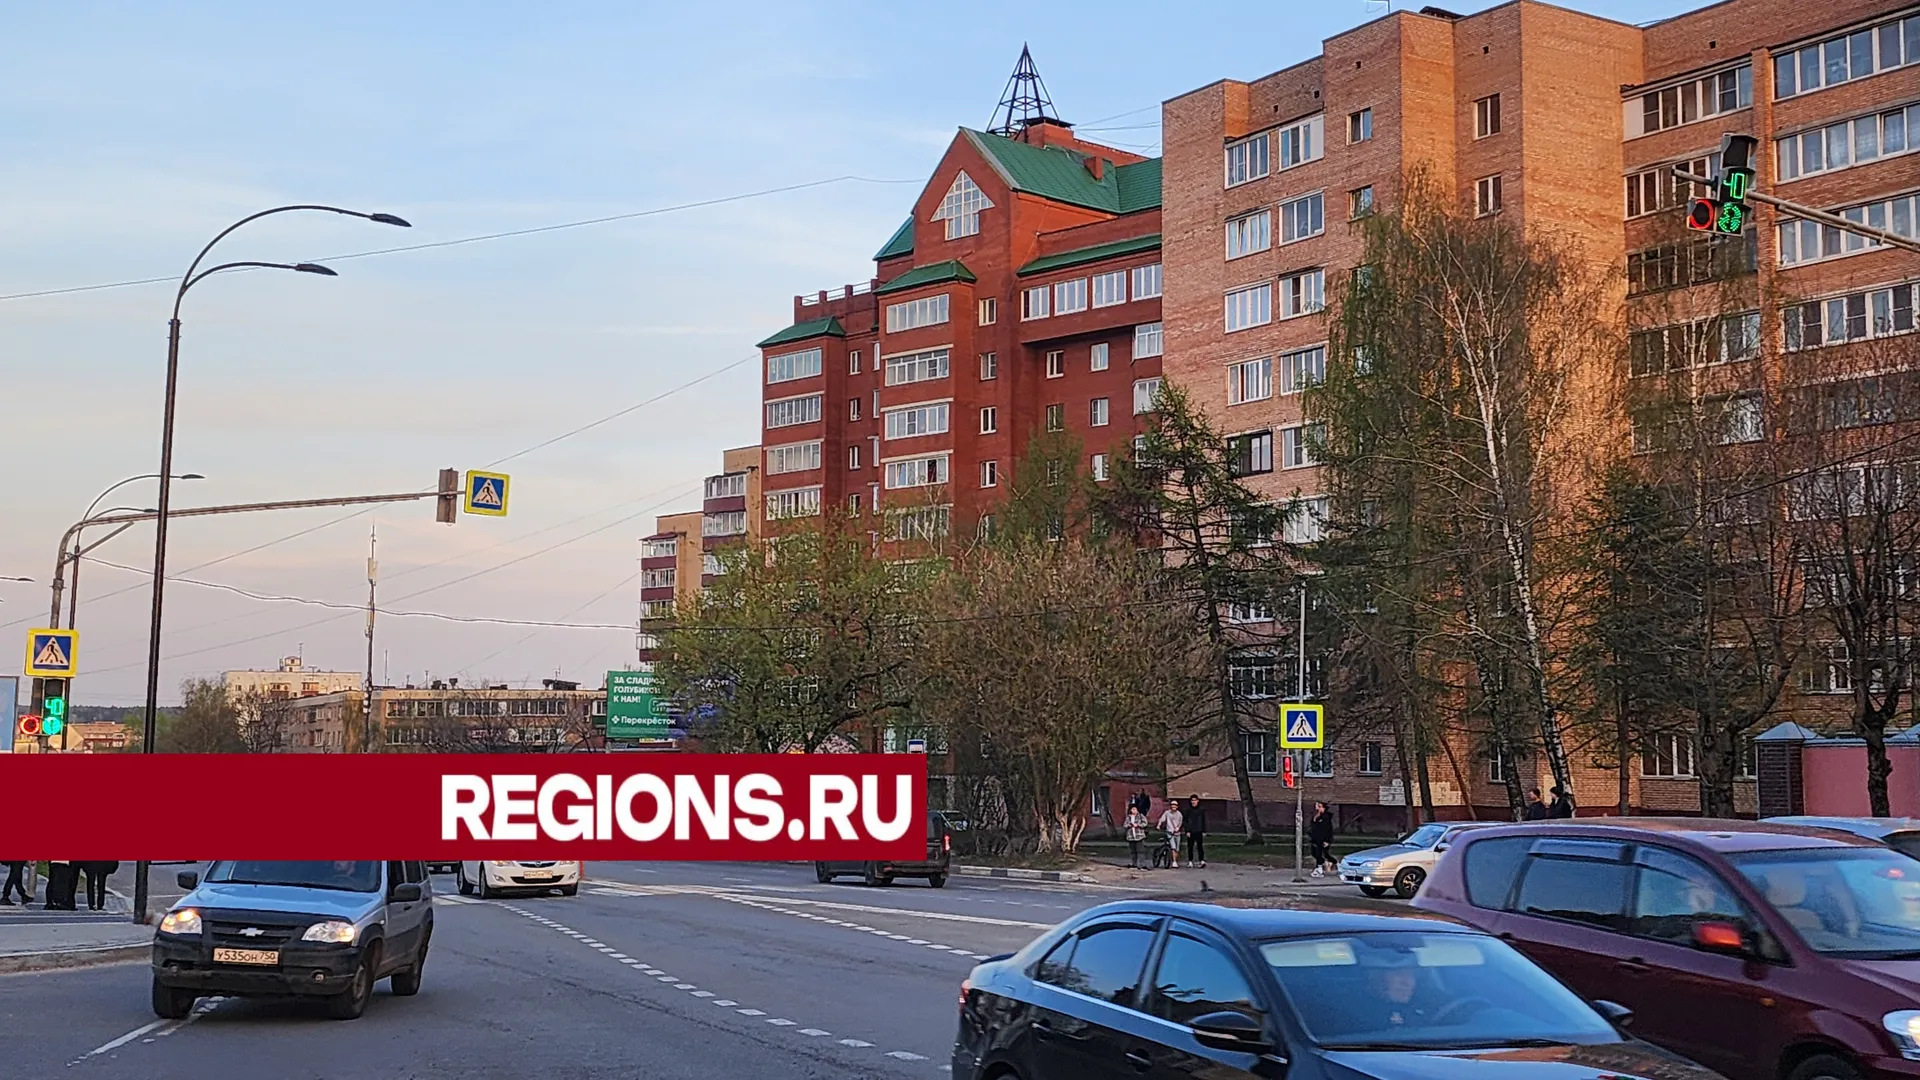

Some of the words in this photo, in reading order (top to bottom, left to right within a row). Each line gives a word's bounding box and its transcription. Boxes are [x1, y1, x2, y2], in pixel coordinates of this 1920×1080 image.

[1723, 173, 1745, 199] 40
[613, 676, 625, 684] ЗА
[613, 695, 619, 703] К
[620, 695, 641, 703] НАМ!
[45, 698, 63, 715] 40
[621, 716, 676, 726] Перекрёсток
[260, 951, 276, 960] 750
